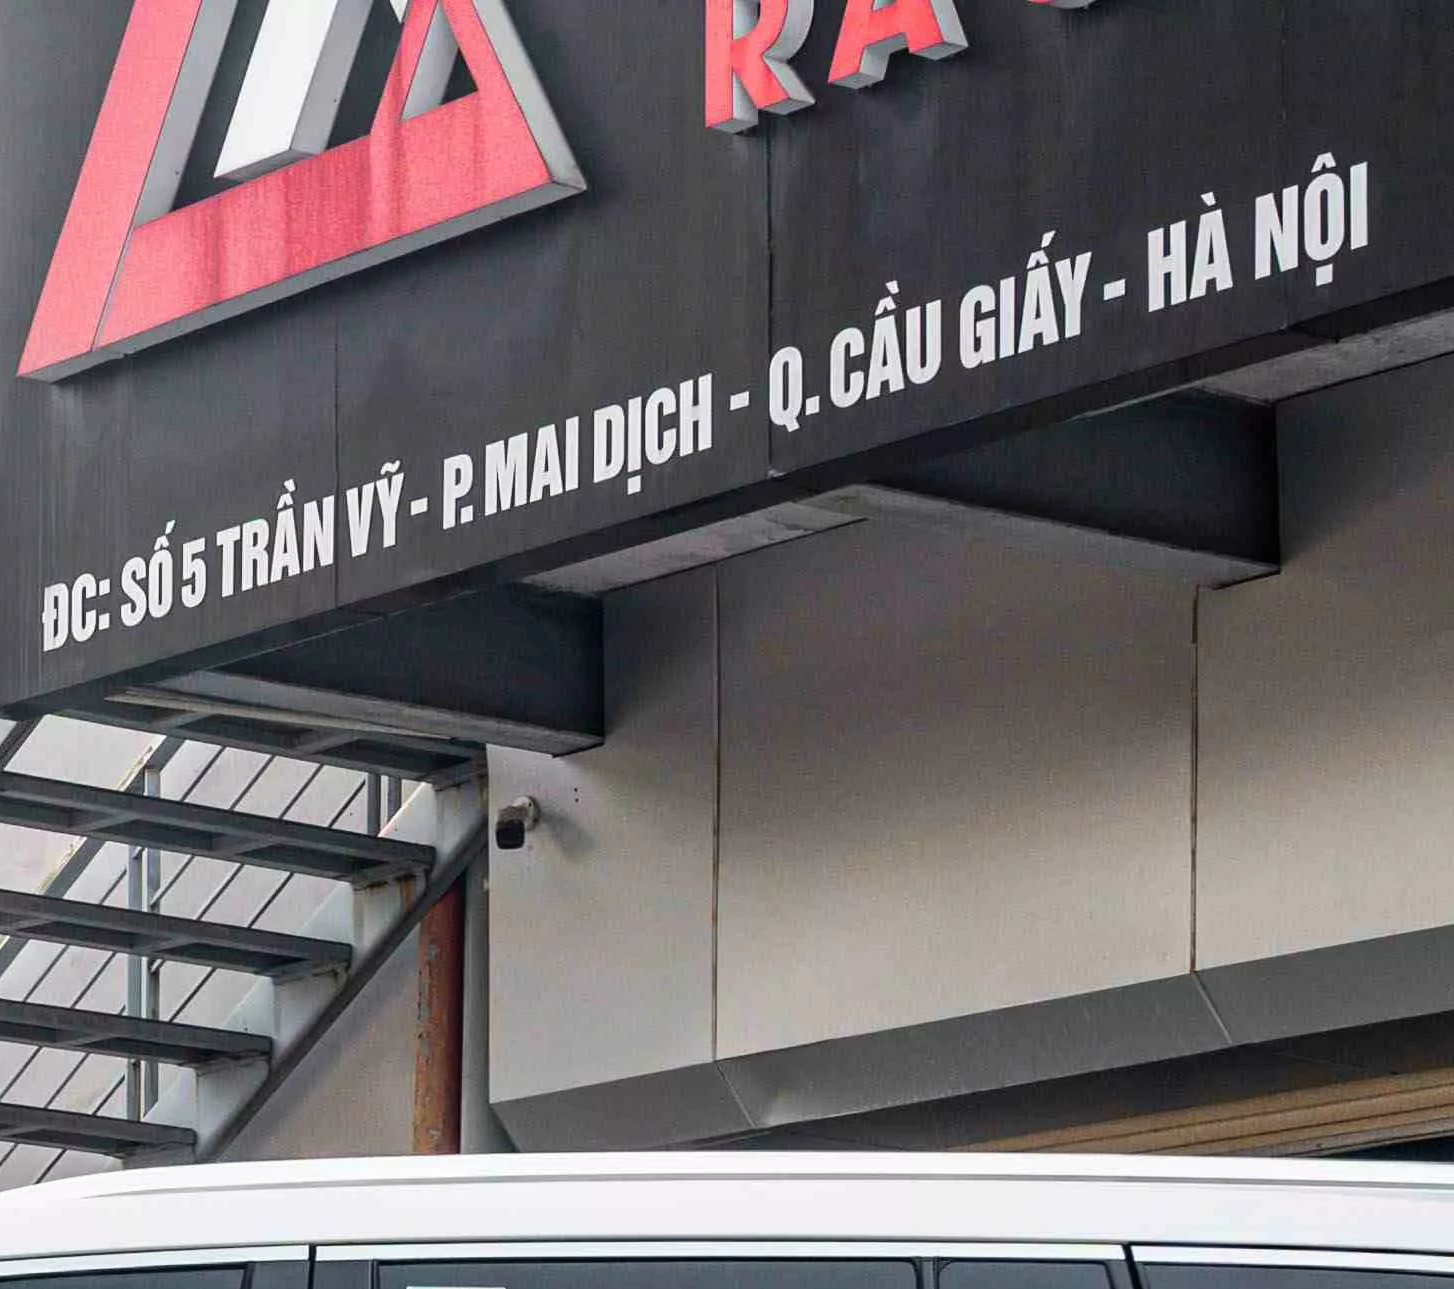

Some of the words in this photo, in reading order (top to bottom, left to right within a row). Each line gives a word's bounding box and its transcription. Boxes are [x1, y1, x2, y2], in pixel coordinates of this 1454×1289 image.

[42, 572, 111, 653] ĐC:
[120, 519, 175, 627] SỐ
[181, 537, 207, 608] 5
[216, 478, 335, 598] TRẦN
[346, 460, 405, 559] VỸ
[485, 416, 580, 516] MAI
[594, 373, 713, 495] DỊCH
[769, 346, 820, 432] Q.
[829, 280, 942, 408] CẦU
[959, 230, 1092, 369] GIẤY
[1147, 192, 1234, 313] HÀ
[1254, 151, 1369, 287] NỘI
